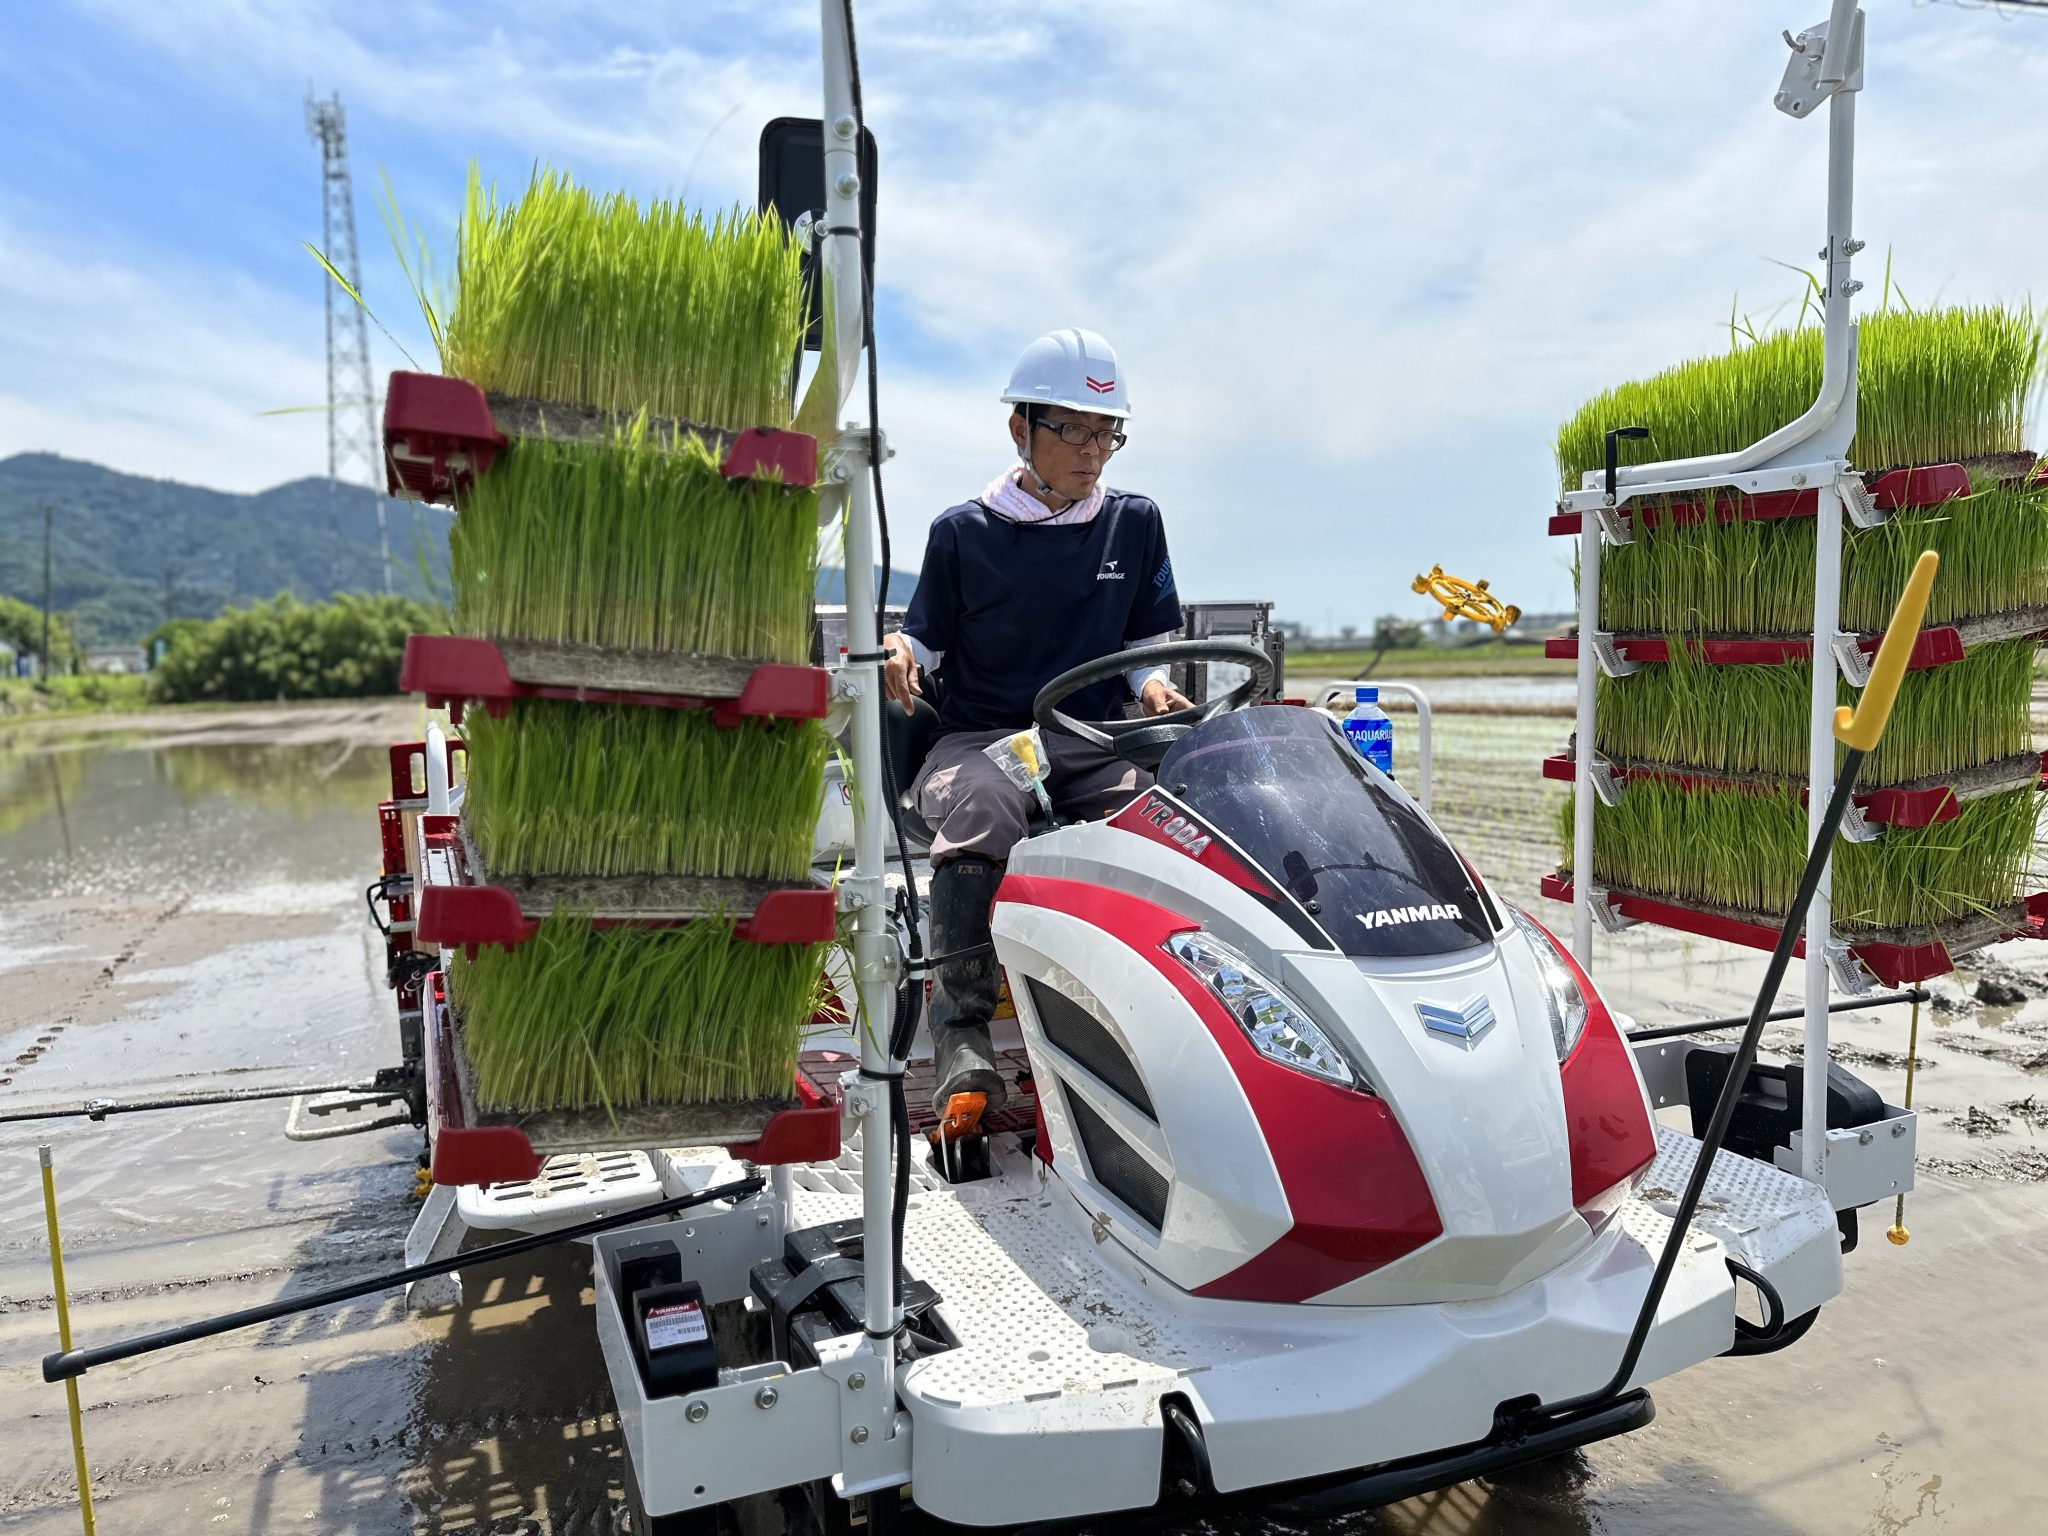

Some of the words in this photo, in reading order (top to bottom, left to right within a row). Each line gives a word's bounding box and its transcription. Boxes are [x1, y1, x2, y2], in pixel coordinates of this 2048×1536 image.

[1139, 795, 1212, 857] YR8DA
[1355, 904, 1463, 930] YANMAR
[655, 1303, 690, 1315] YANMAR
